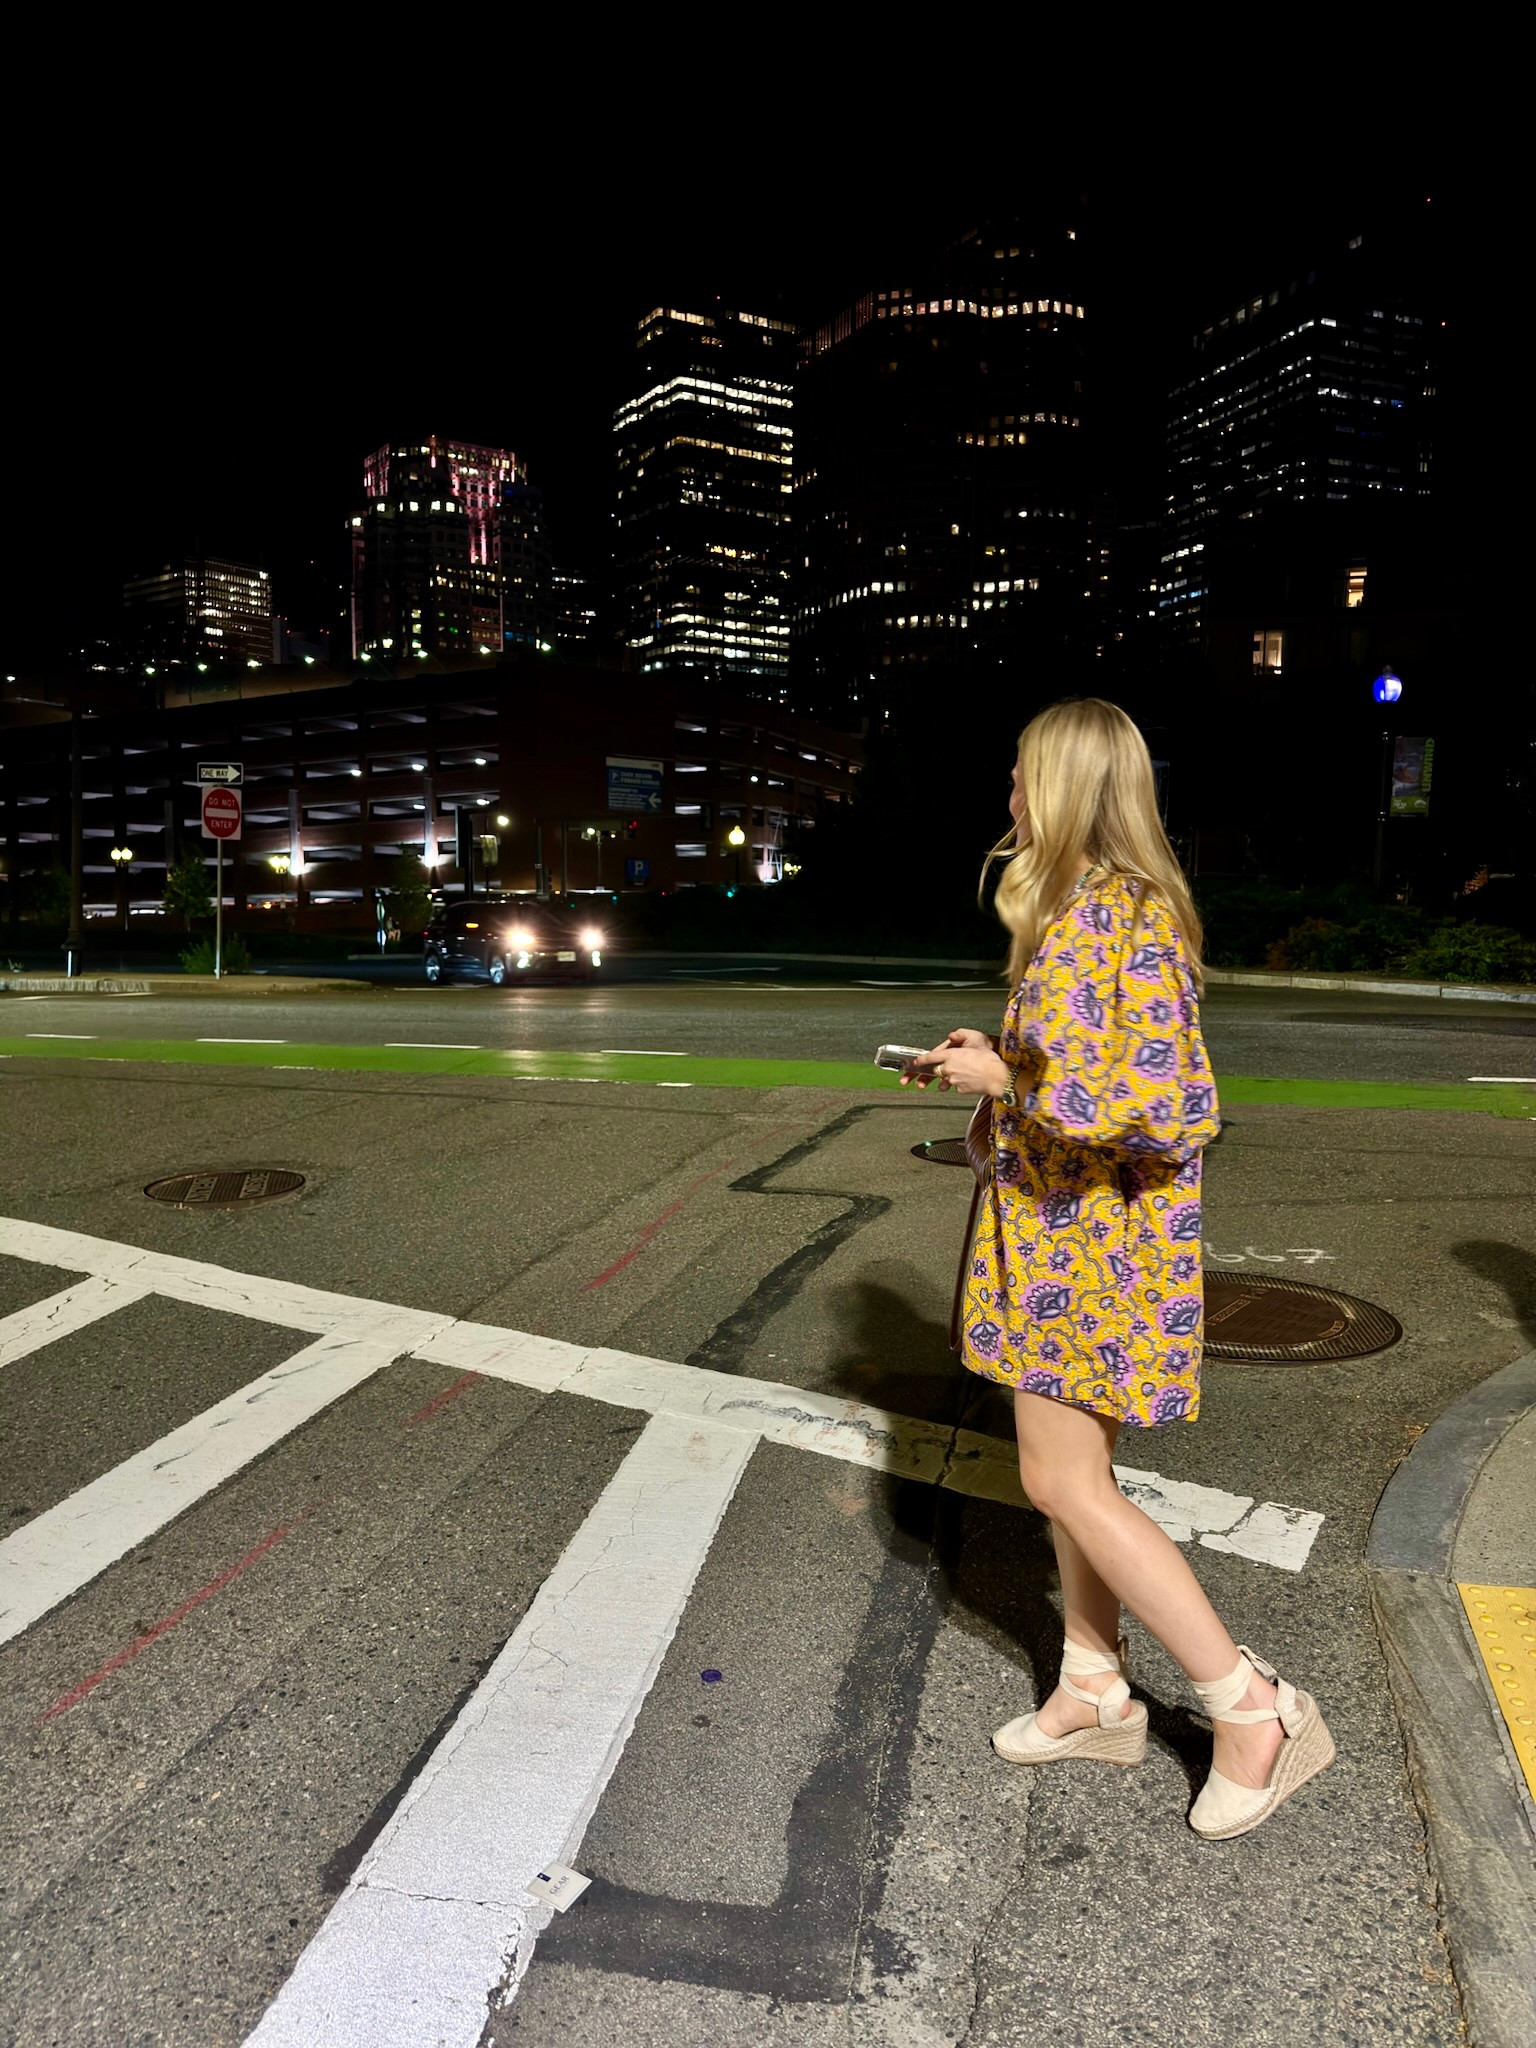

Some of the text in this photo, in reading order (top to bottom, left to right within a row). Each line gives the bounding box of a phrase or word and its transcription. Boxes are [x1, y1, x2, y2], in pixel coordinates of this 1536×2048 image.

[1422, 738, 1434, 792] UNWIND
[201, 769, 228, 777] ONE WAY
[208, 797, 235, 807] DO NOT
[211, 819, 233, 829] ENTER
[634, 859, 644, 875] P
[549, 1875, 569, 1895] GEAR
